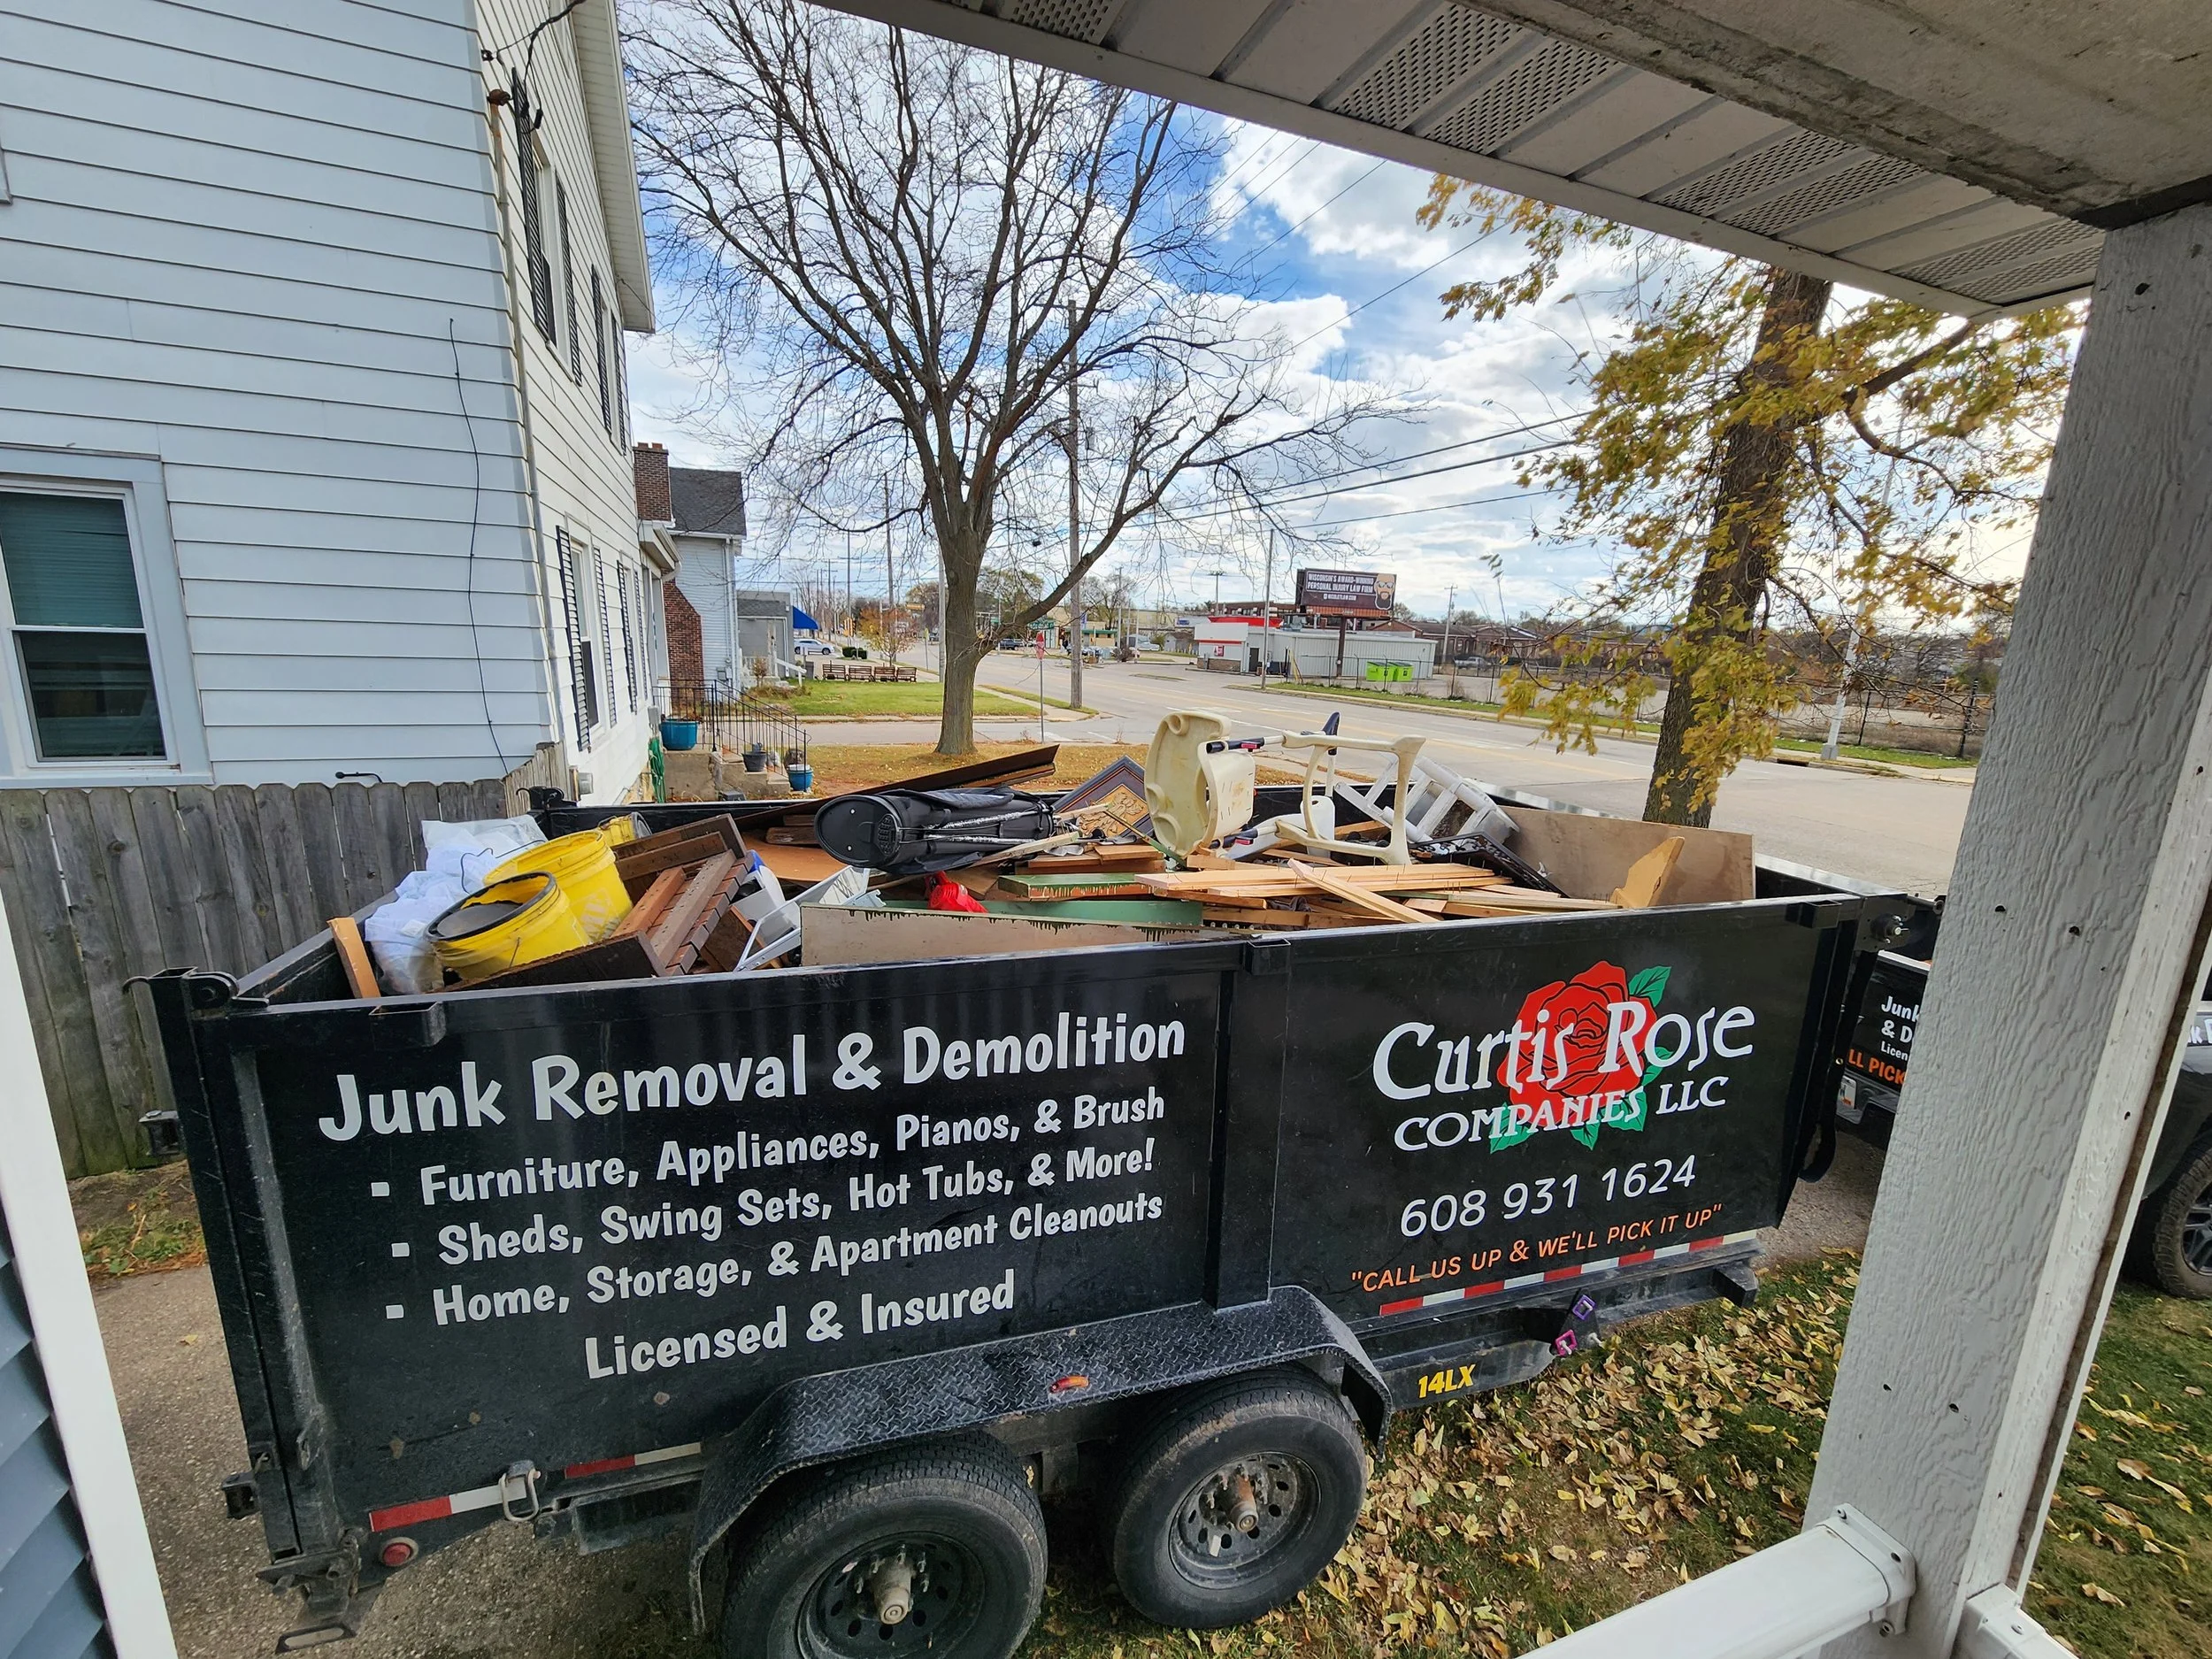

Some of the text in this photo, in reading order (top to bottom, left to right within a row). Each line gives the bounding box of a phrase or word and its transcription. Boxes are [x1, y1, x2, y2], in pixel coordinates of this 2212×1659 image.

[1307, 581, 1373, 594] PERSONAL INJURY LAW FIRM
[1308, 572, 1337, 585] WISCONSIN'S
[1373, 1002, 1755, 1099] Curtis Rose
[1869, 1057, 1906, 1085] PICK
[1881, 1019, 1895, 1039] &
[319, 1012, 1184, 1141] Junk Removal & Demolition
[1394, 1077, 1728, 1150] COMPANIES LLC
[421, 1087, 1164, 1204] Furniture, Appliances, Pianos, & Brush
[439, 1138, 1155, 1264] Sheds, Swing Sets, Hot Tubs, & More!
[1402, 1156, 1694, 1236] 608 931 1624
[434, 1193, 1162, 1325] Home, Storage, & Apartment Cleanouts
[1352, 1204, 1722, 1292] "CALL US UP & WE'LL PICK IT UP"
[586, 1269, 1013, 1379] Licensed & Insured
[1418, 1365, 1476, 1398] 14LX
